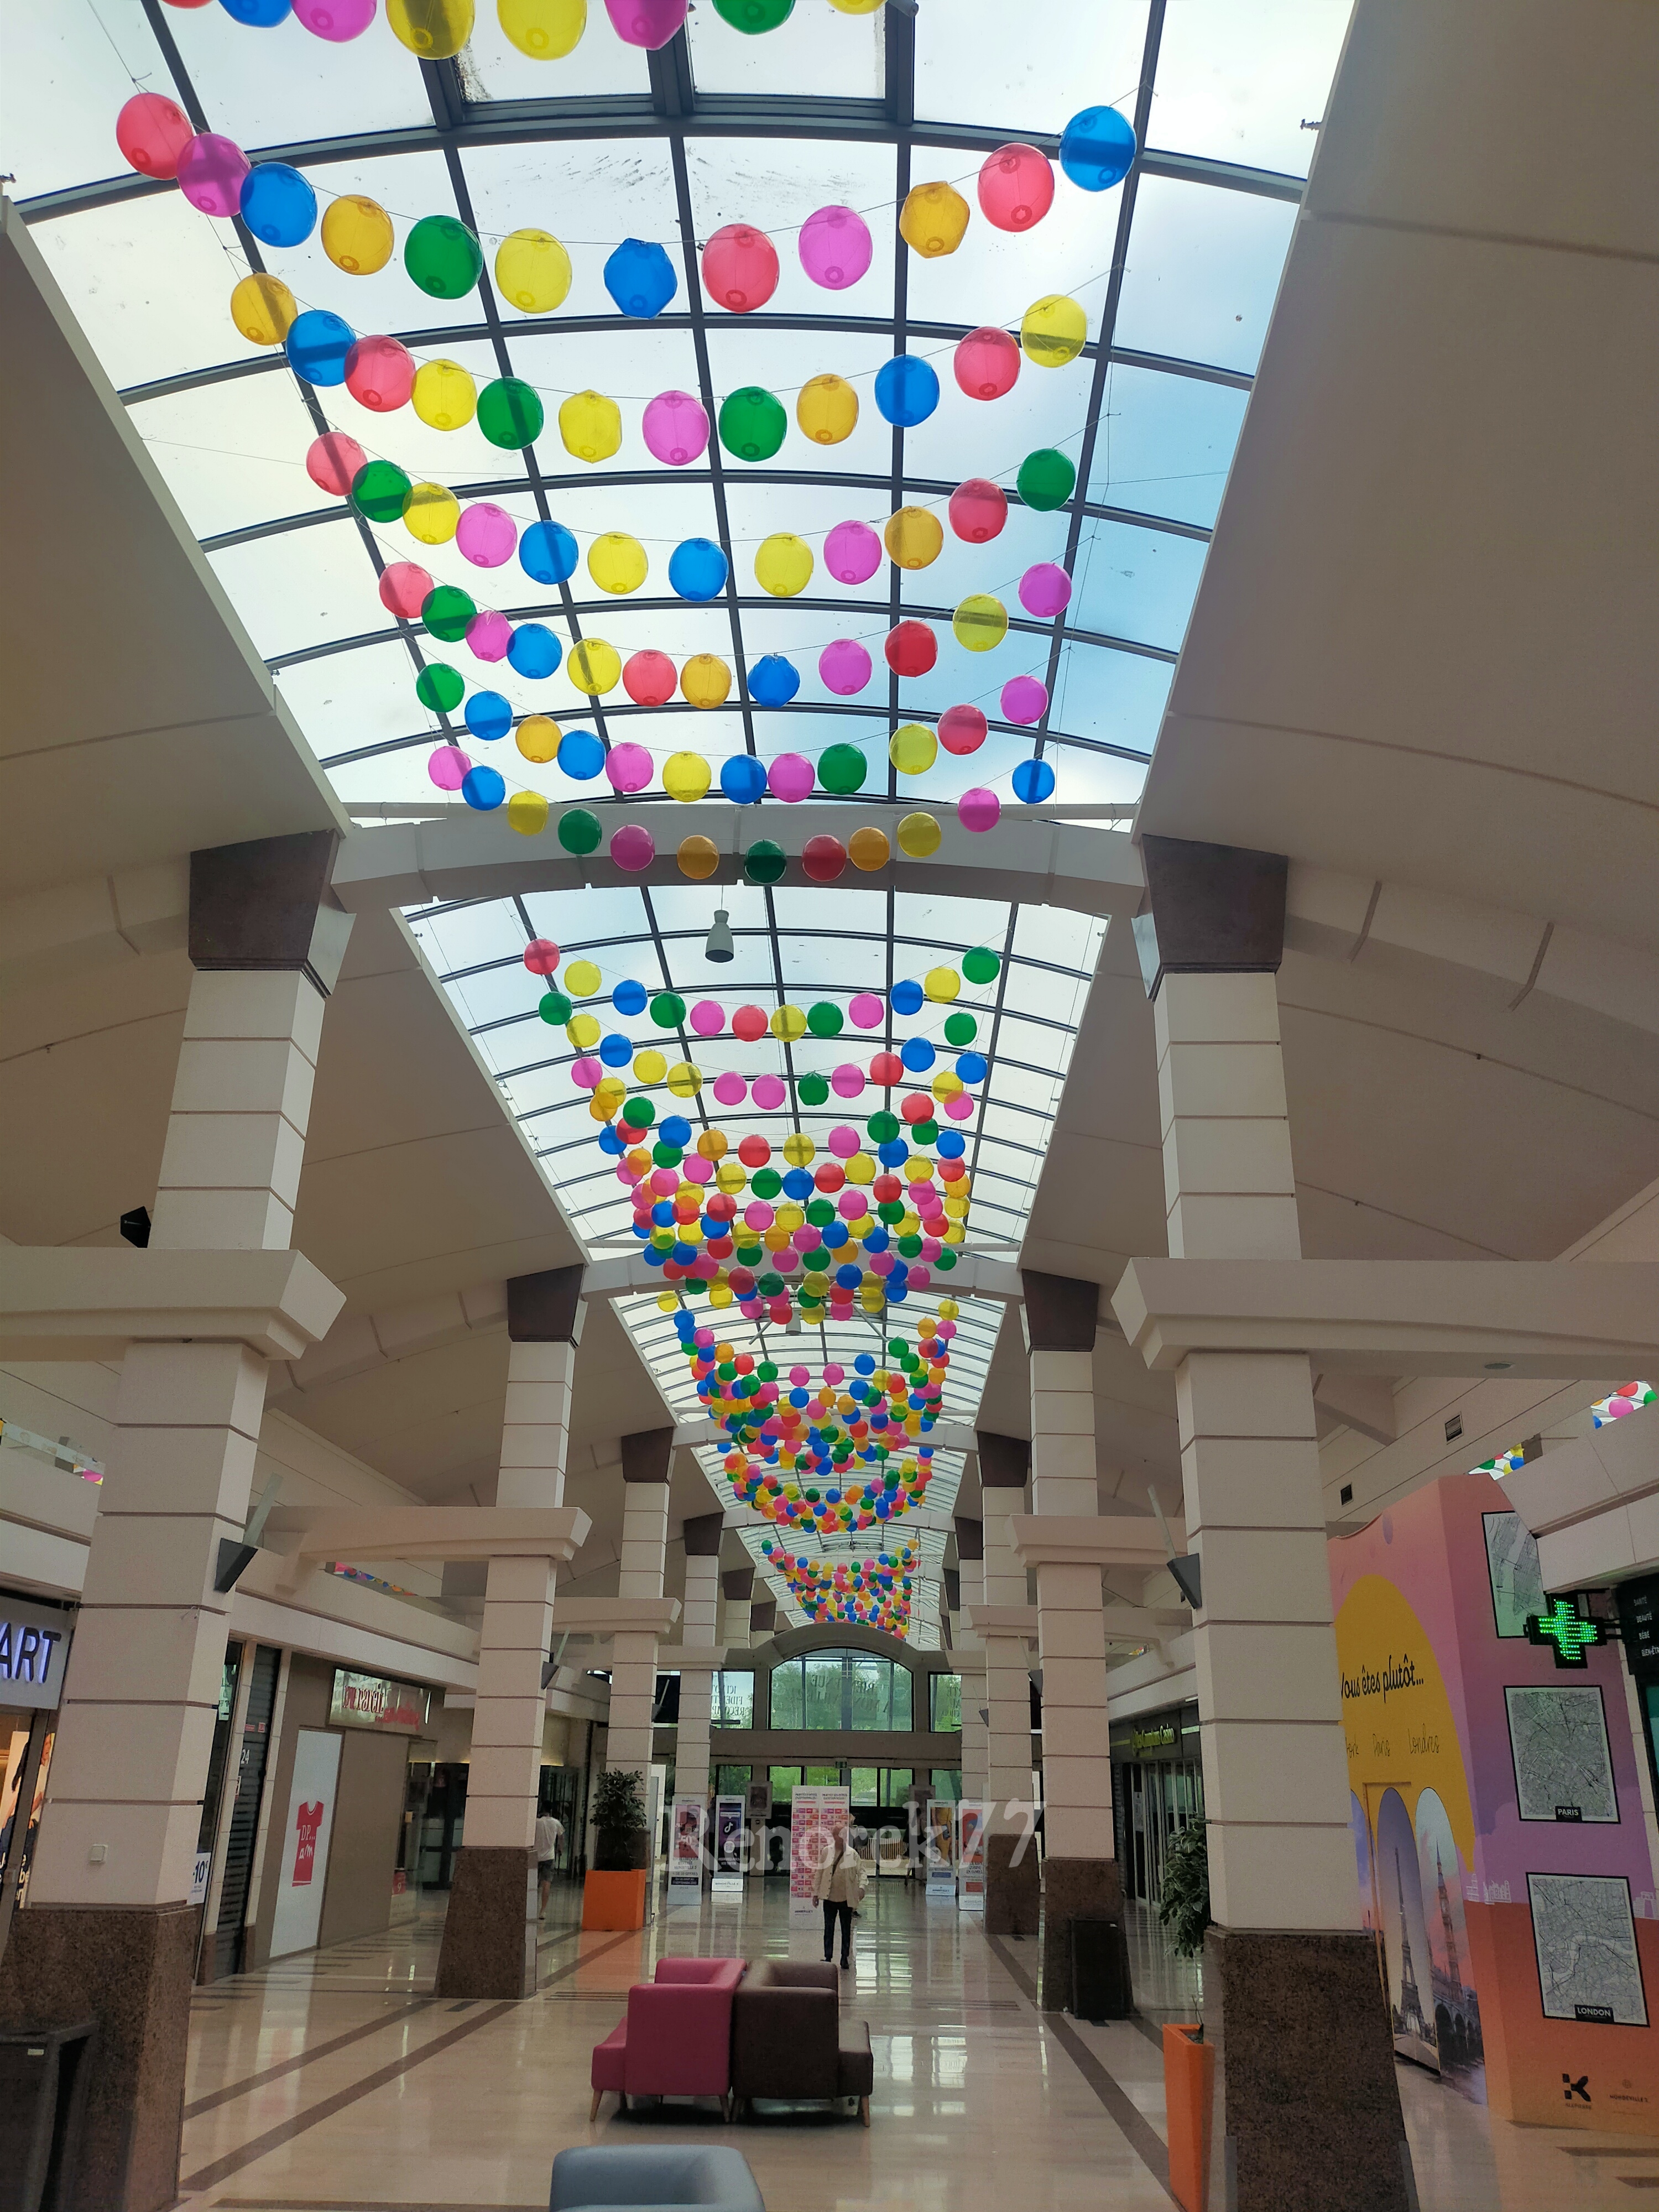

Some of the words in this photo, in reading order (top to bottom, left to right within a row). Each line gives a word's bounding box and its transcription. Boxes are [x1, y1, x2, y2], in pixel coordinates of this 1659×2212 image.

[1362, 1665, 1380, 1695] êtes
[1408, 1723, 1439, 1754] Londres
[241, 1749, 250, 1764] 24
[1577, 2007, 1611, 2016] LONDON
